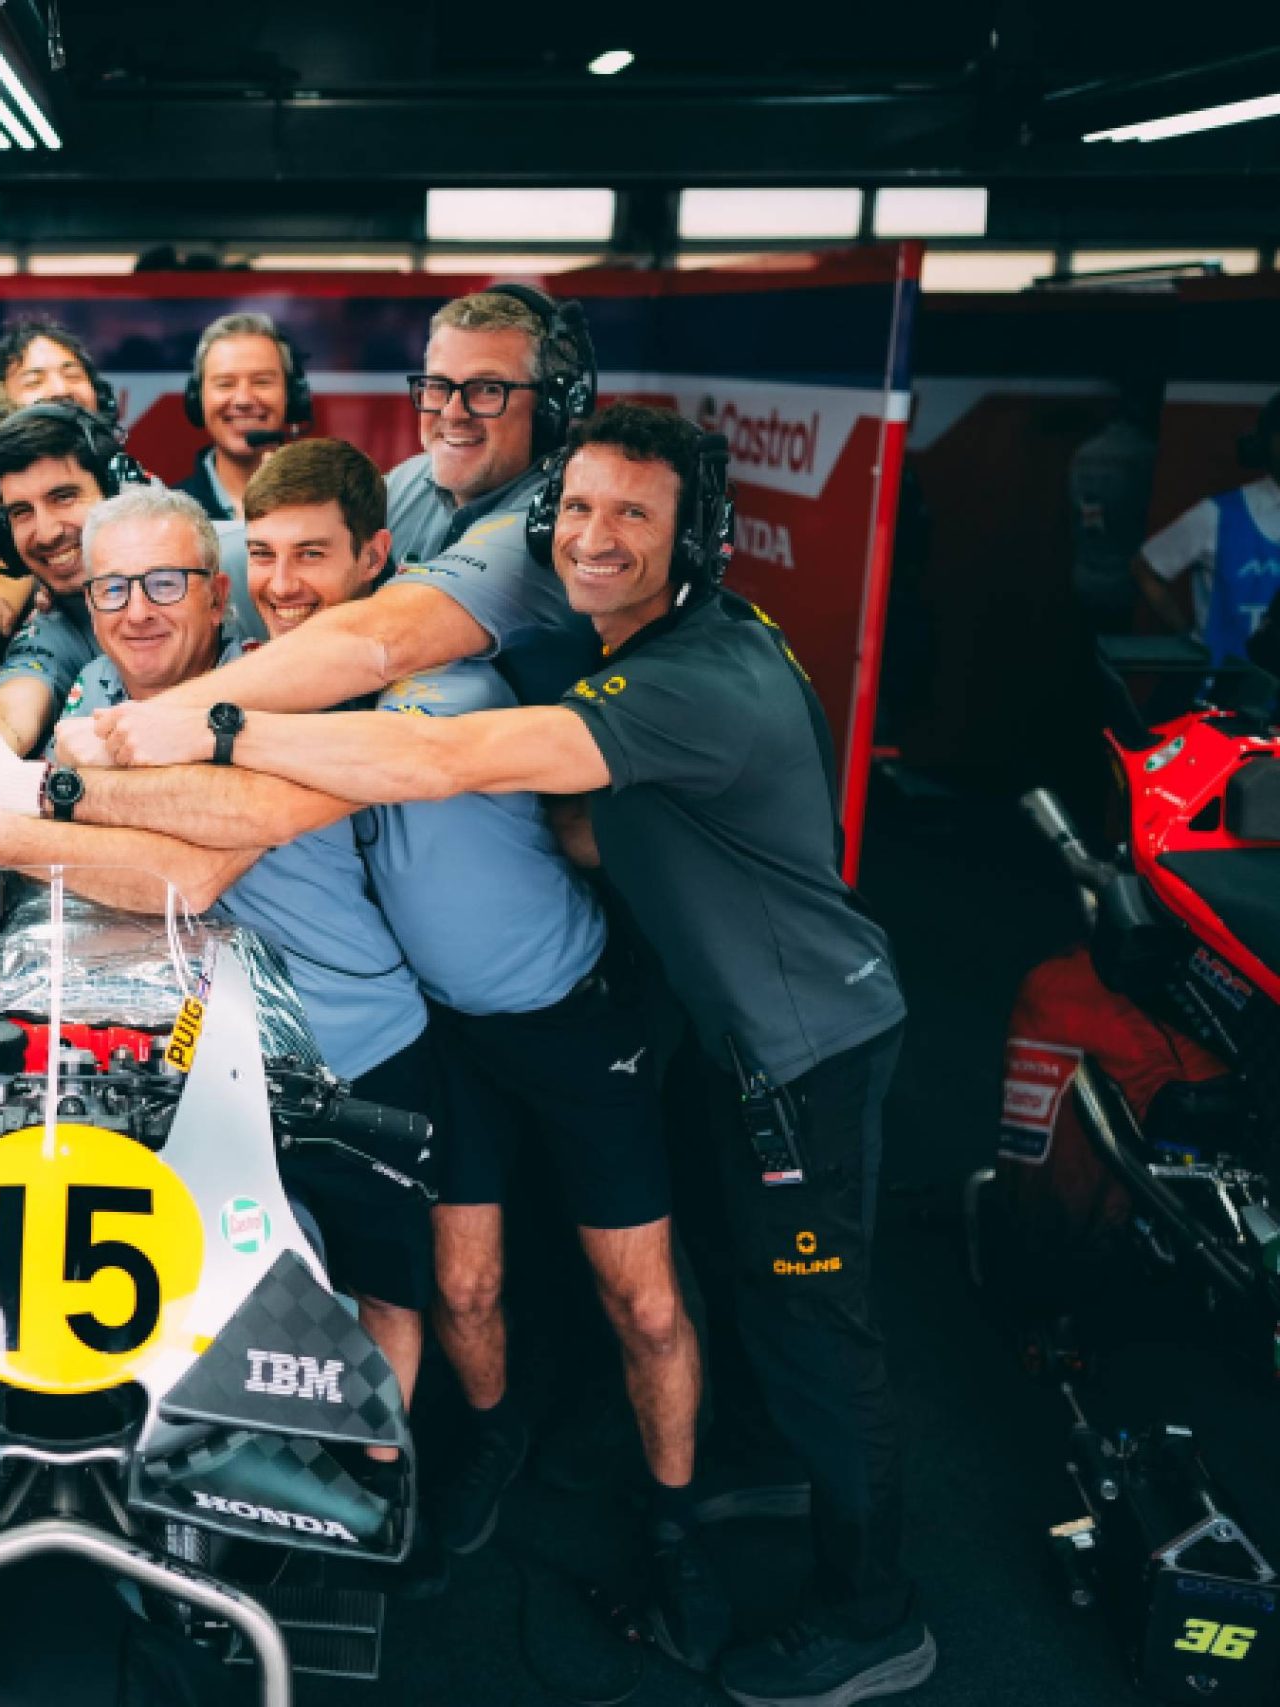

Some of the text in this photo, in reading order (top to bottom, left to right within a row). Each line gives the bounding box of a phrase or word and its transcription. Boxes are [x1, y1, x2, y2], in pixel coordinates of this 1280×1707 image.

[722, 402, 820, 476] Castrol
[734, 514, 795, 570] NDA
[167, 997, 203, 1069] PUIG
[245, 1349, 345, 1403] IBM
[192, 1490, 359, 1543] HONDA
[1174, 1618, 1258, 1660] 36
